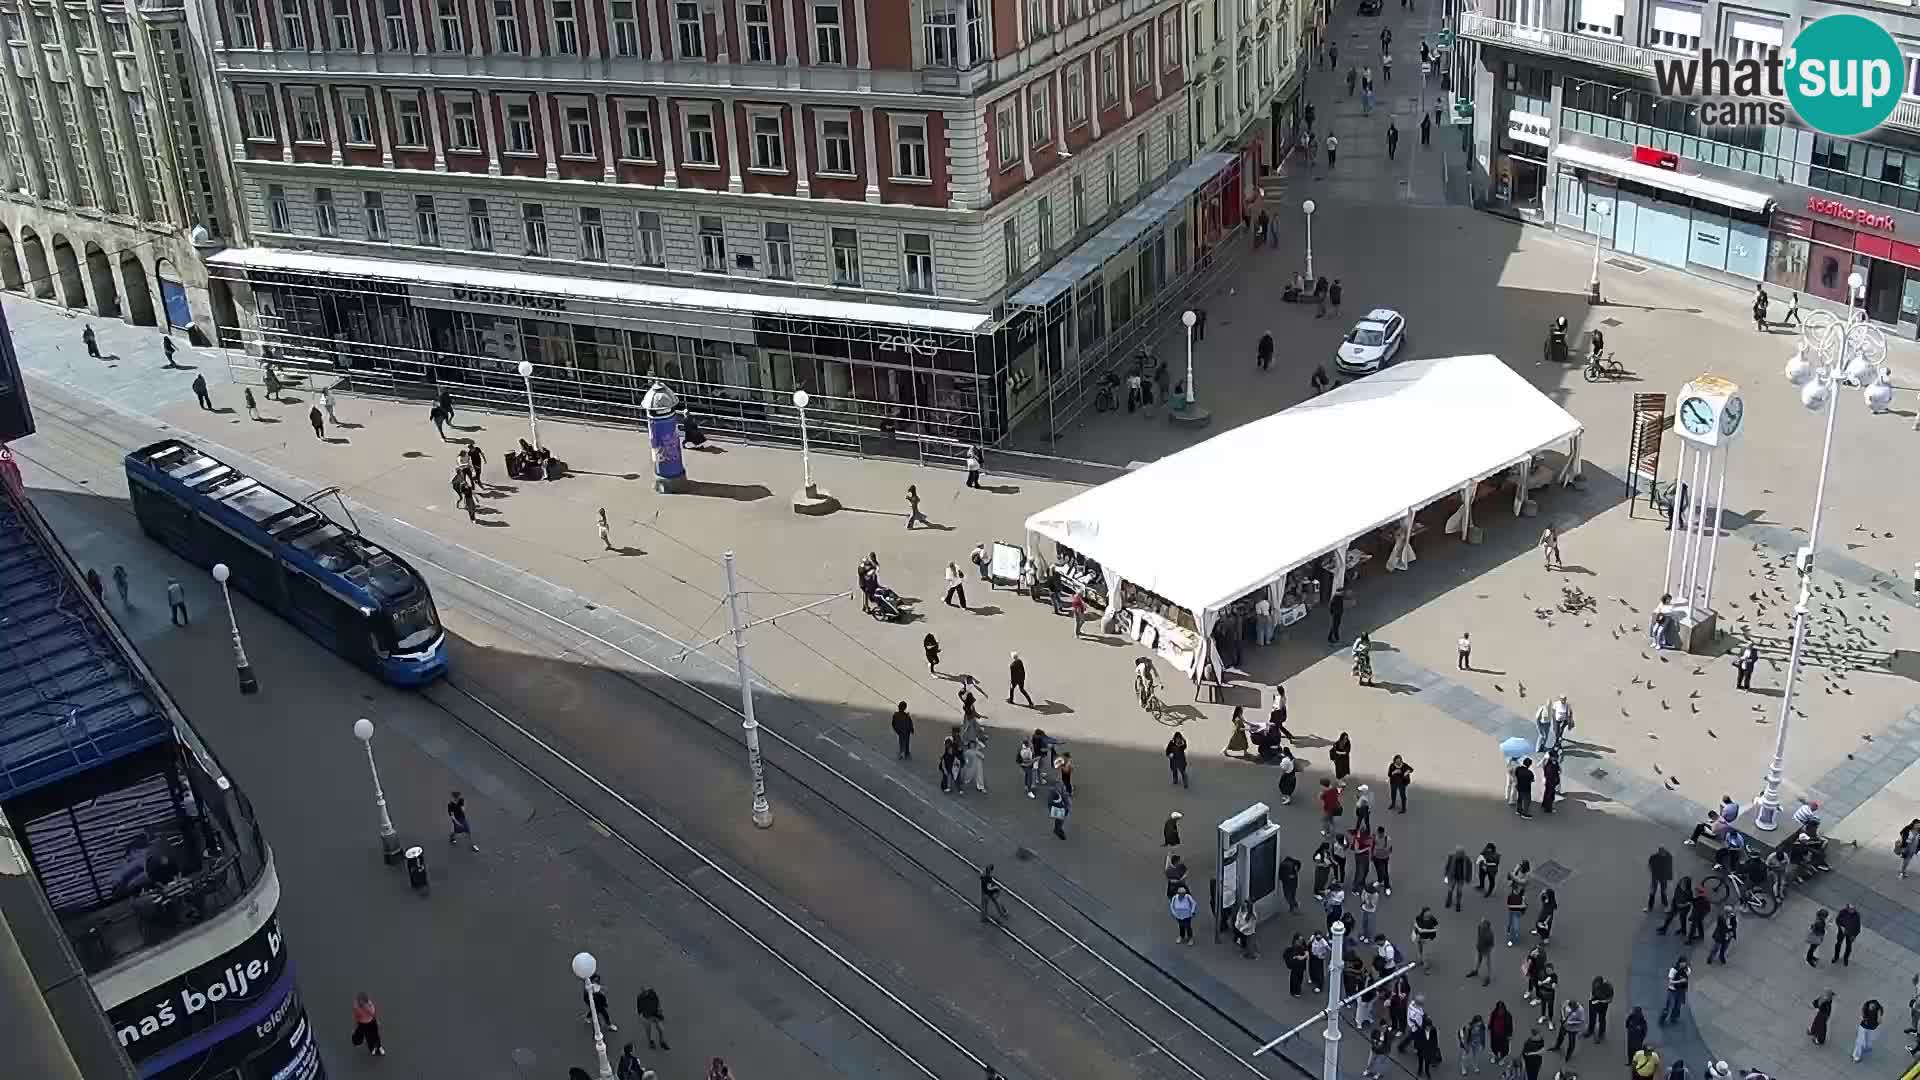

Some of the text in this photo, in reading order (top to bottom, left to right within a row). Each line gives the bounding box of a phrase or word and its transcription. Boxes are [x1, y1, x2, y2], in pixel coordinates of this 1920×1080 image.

[1807, 195, 1896, 232] Addiko Bank
[878, 333, 939, 357] ZAKS
[116, 999, 177, 1047] naš
[181, 958, 269, 1015] bolje,
